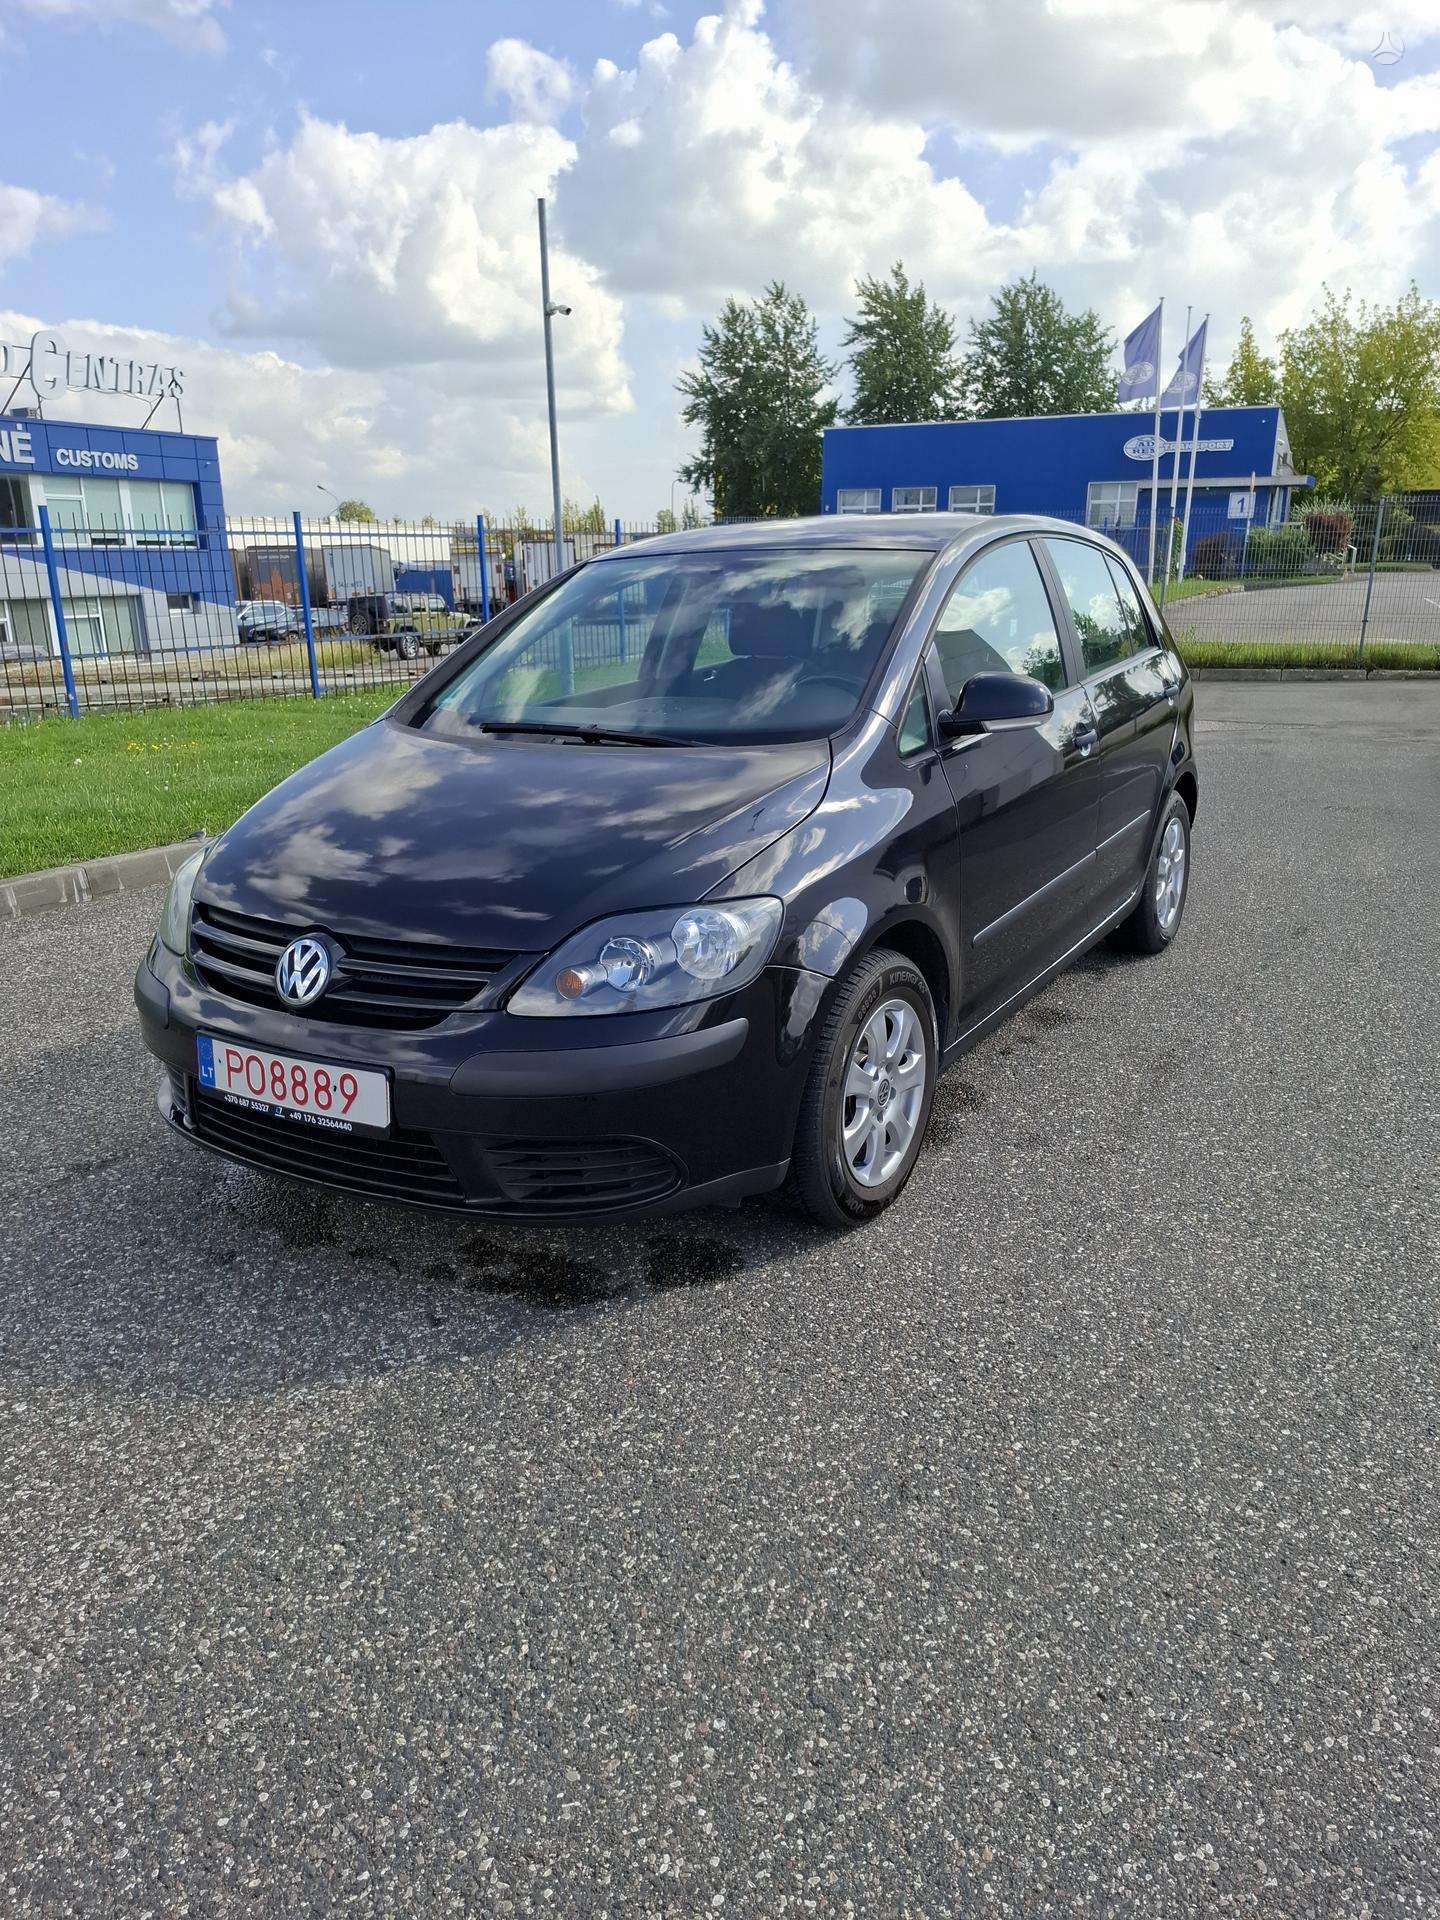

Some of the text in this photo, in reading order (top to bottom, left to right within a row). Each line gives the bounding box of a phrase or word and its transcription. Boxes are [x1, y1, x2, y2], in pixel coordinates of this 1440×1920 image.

[56, 448, 139, 471] CUSTOMS
[1237, 496, 1246, 513] 1
[201, 1065, 215, 1078] LT
[289, 1111, 301, 1120] +49
[303, 1114, 316, 1124] 176
